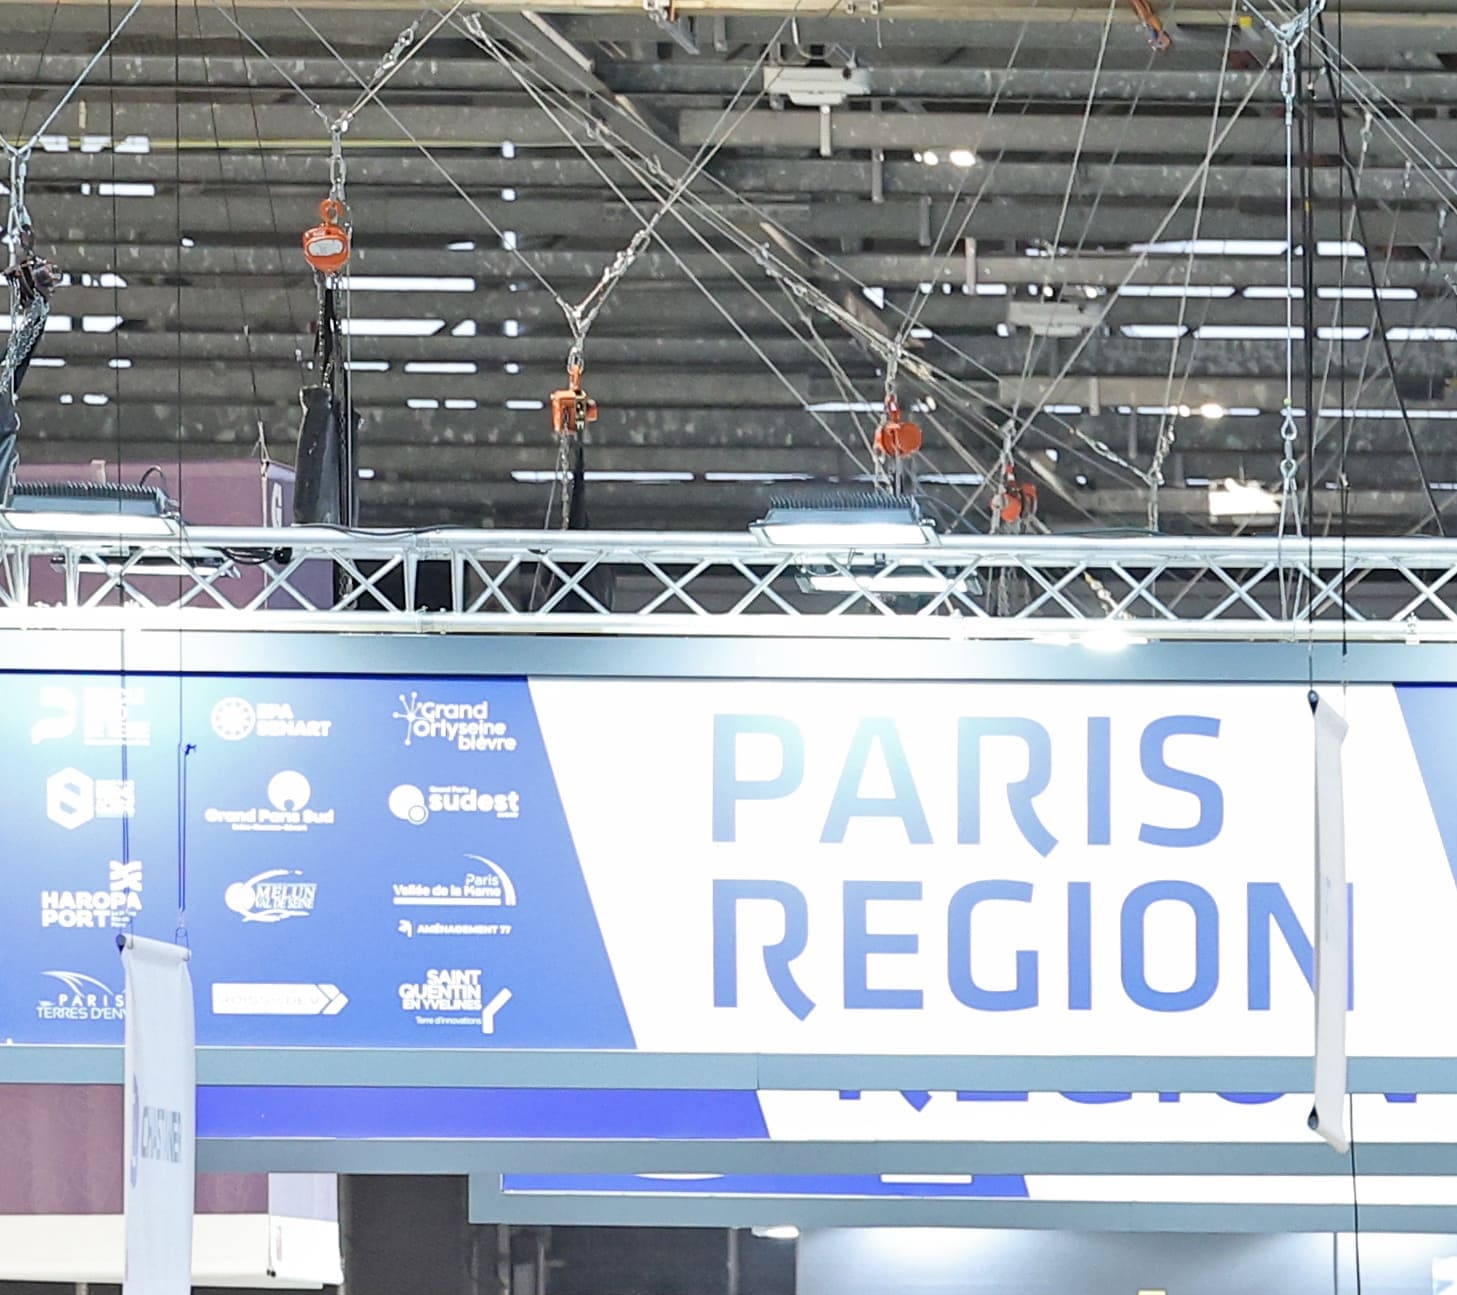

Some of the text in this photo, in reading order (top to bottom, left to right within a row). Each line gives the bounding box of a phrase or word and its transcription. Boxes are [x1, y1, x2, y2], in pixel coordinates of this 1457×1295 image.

[712, 713, 1225, 858] PARIS
[41, 891, 142, 910] HAROPA
[42, 910, 110, 927] PORT
[712, 879, 1354, 1022] REGION
[427, 969, 481, 985] SAINT
[398, 984, 480, 999] QUENTIN
[59, 994, 124, 1007] PARIS
[36, 1007, 88, 1019] TERRES
